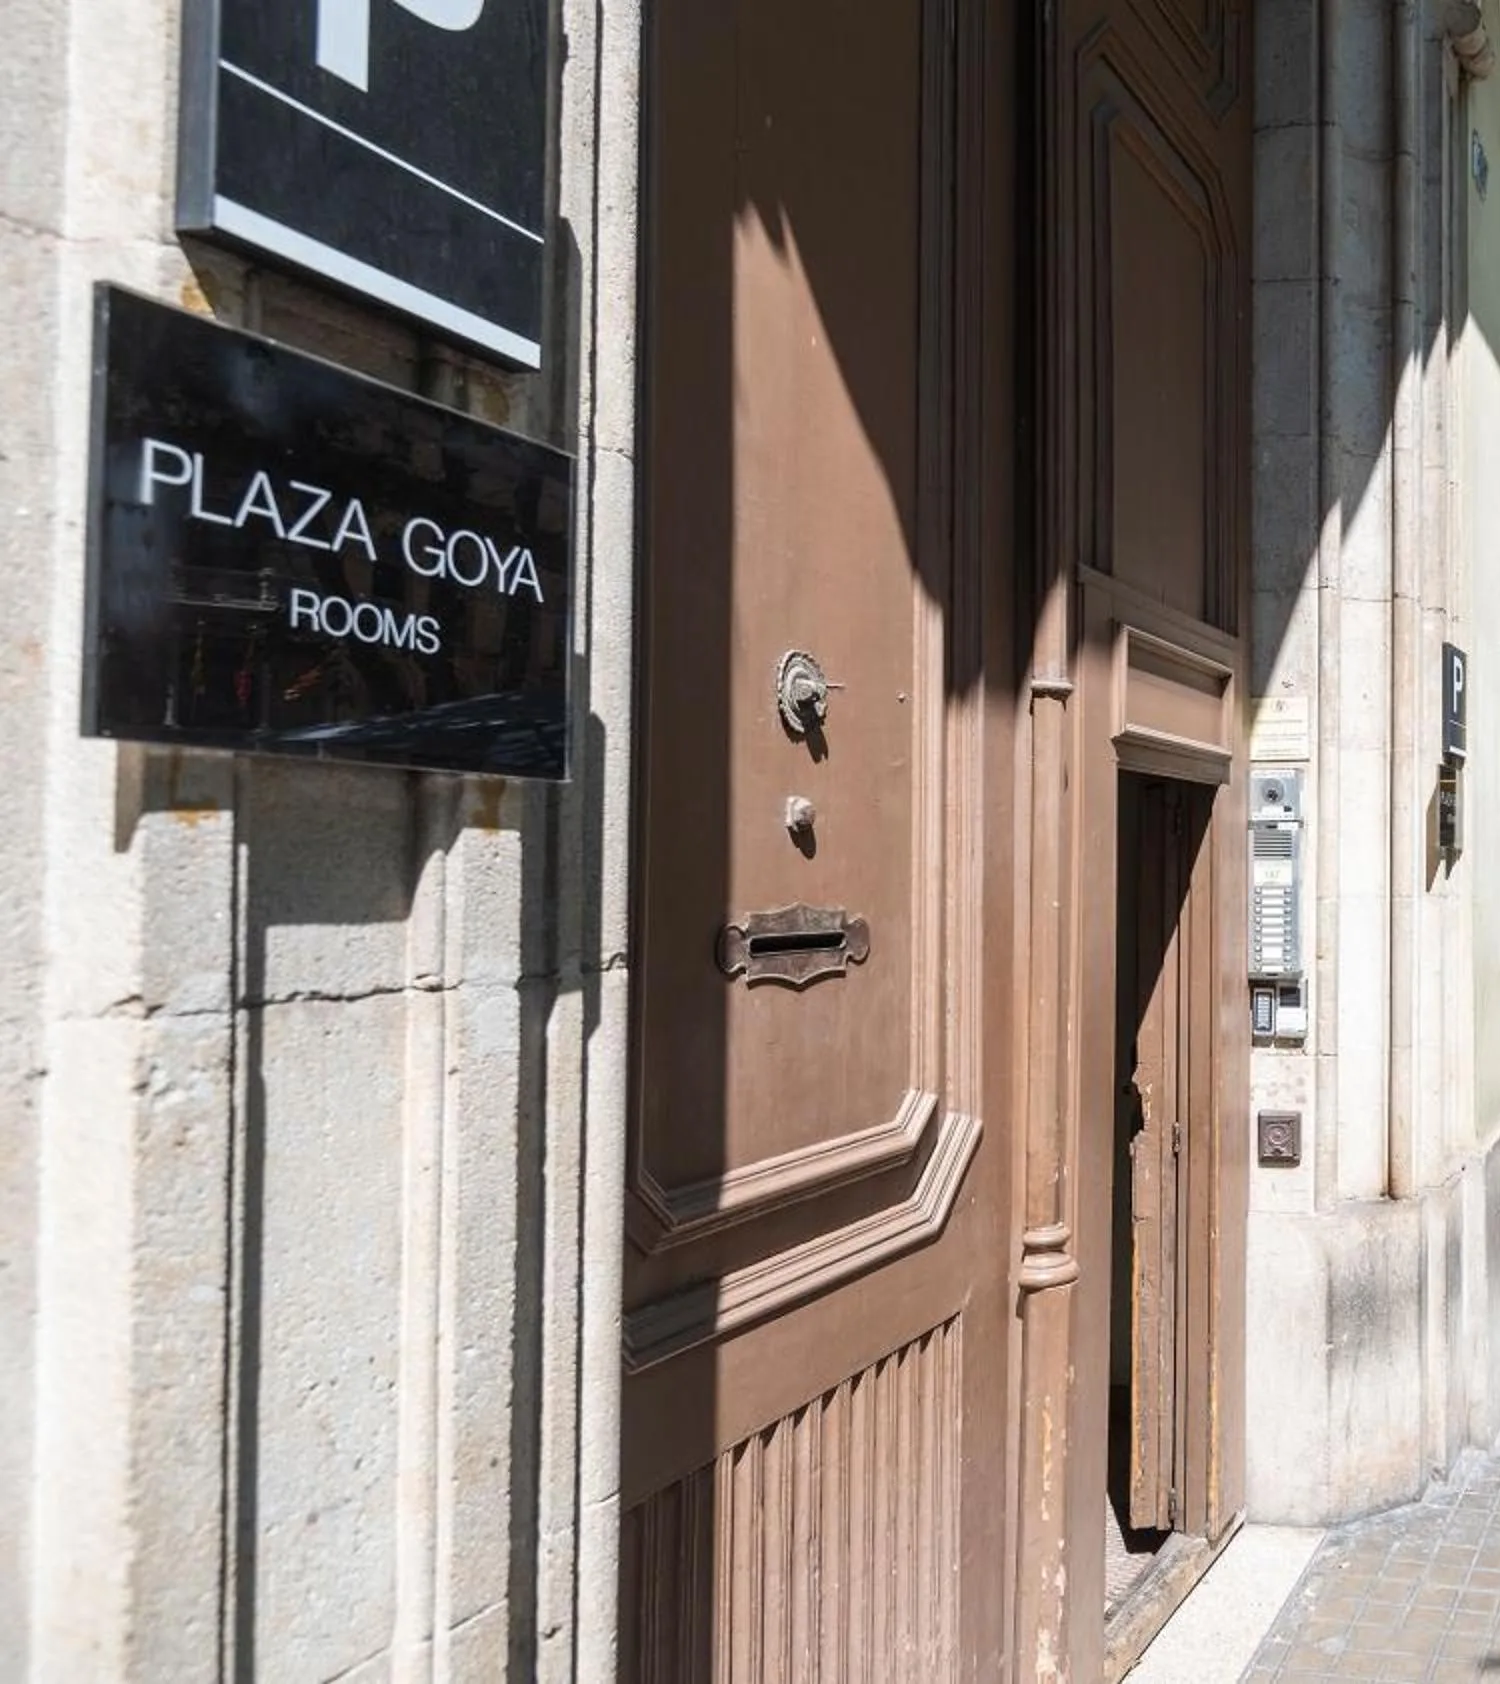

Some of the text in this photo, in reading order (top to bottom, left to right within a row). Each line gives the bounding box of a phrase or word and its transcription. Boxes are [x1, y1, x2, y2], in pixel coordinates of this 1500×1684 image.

[140, 437, 544, 603] PLAZA GOYA
[290, 588, 440, 654] ROOMS
[1453, 655, 1463, 713] P
